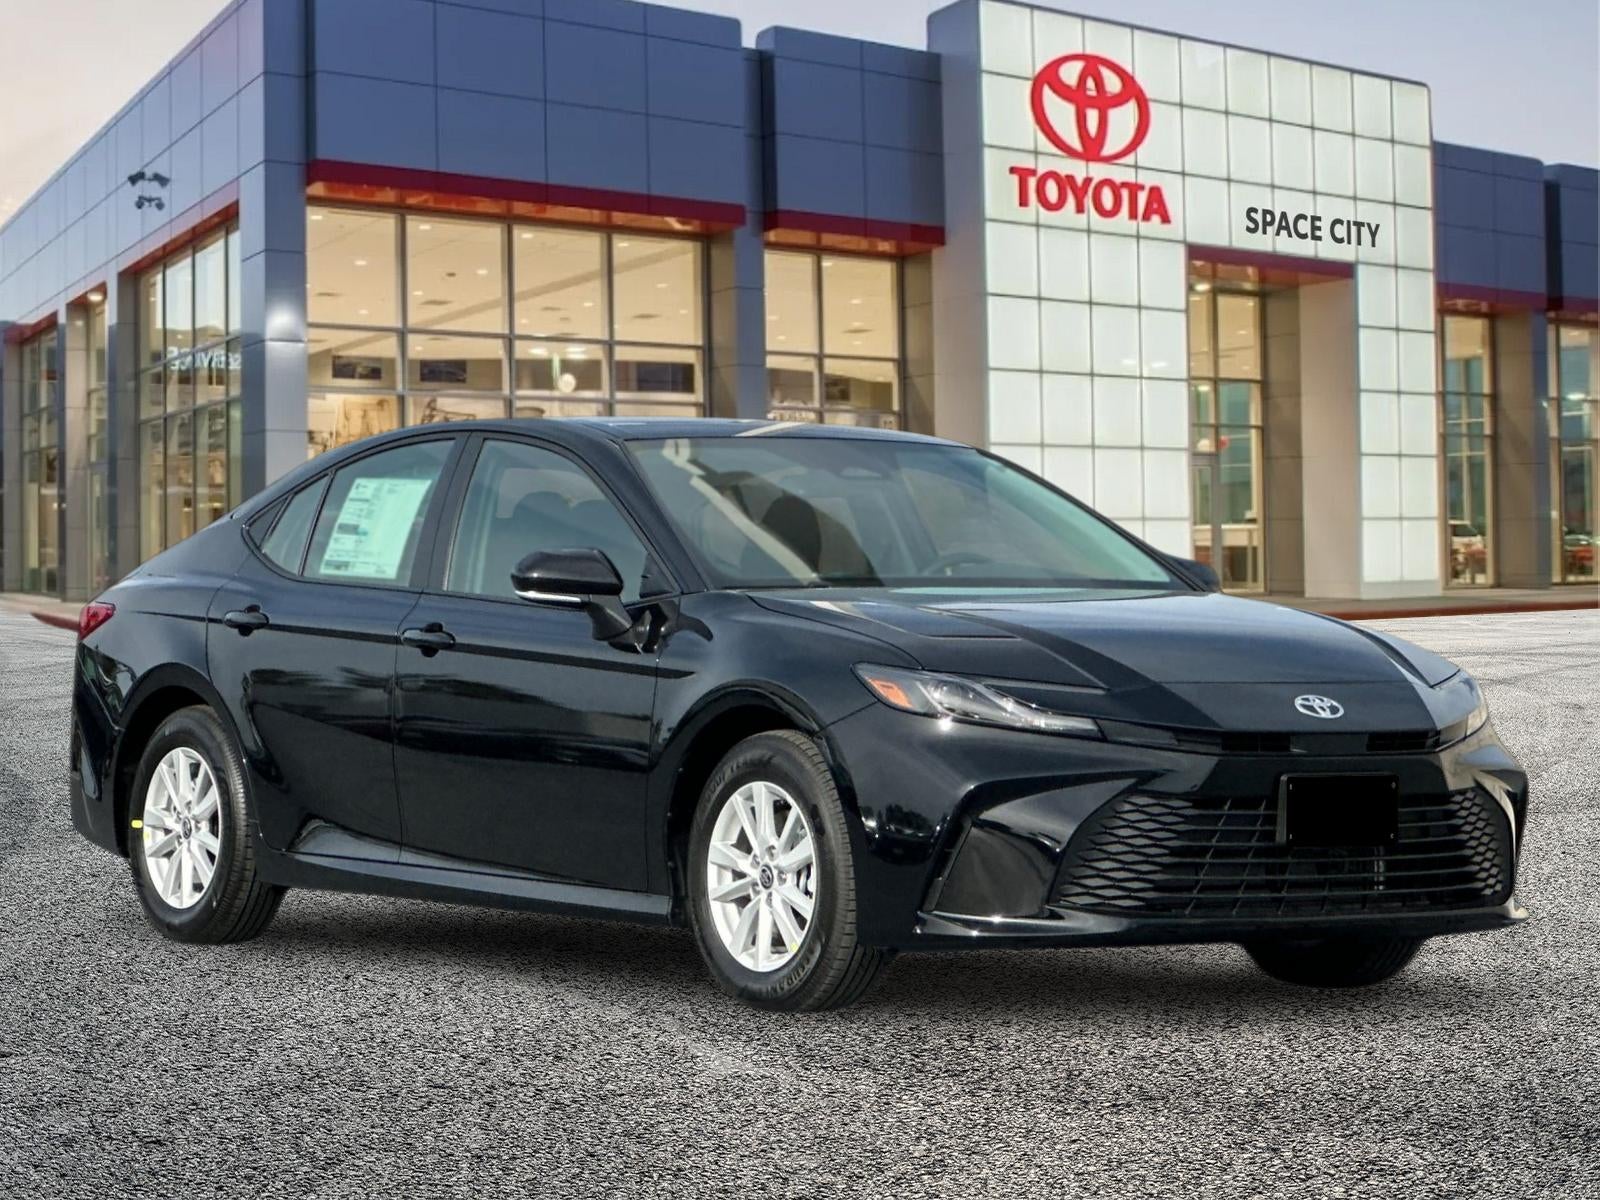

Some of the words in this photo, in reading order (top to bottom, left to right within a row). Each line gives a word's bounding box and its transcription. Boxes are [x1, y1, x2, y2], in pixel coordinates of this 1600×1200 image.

[1009, 166, 1171, 224] TOYOTA
[1246, 207, 1322, 241] SPACE
[1330, 218, 1380, 248] CITY
